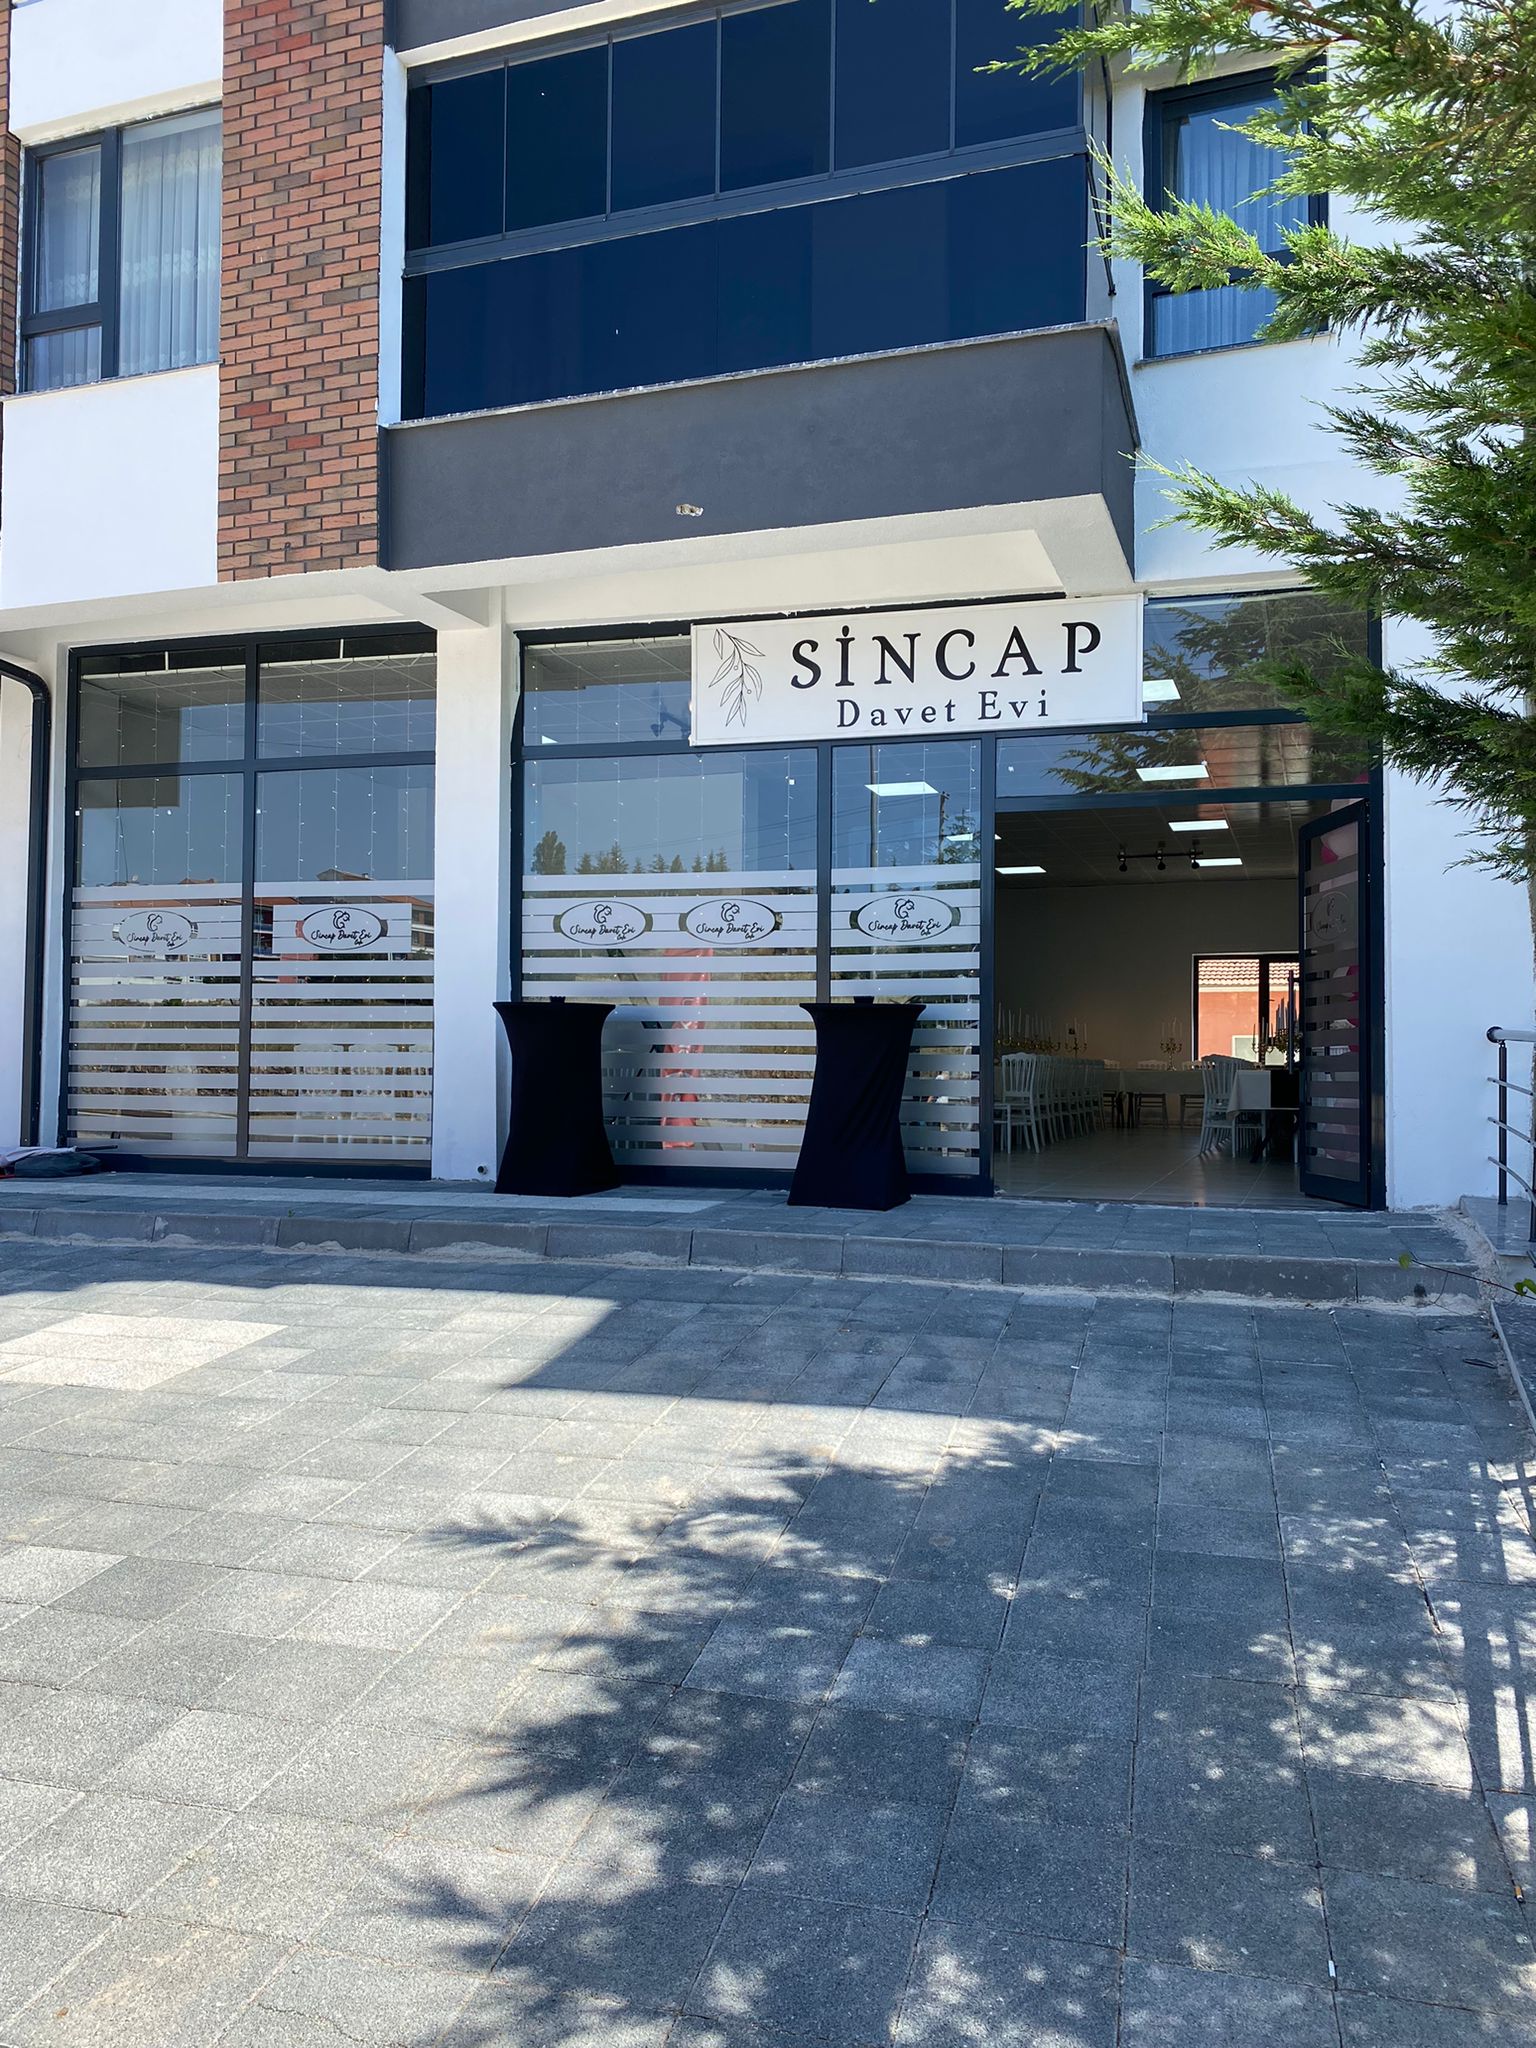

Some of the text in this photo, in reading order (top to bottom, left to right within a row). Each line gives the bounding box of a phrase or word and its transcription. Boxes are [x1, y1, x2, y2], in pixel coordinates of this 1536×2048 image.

[790, 621, 1101, 689] SİNCAP
[837, 690, 1050, 728] Davet Evi
